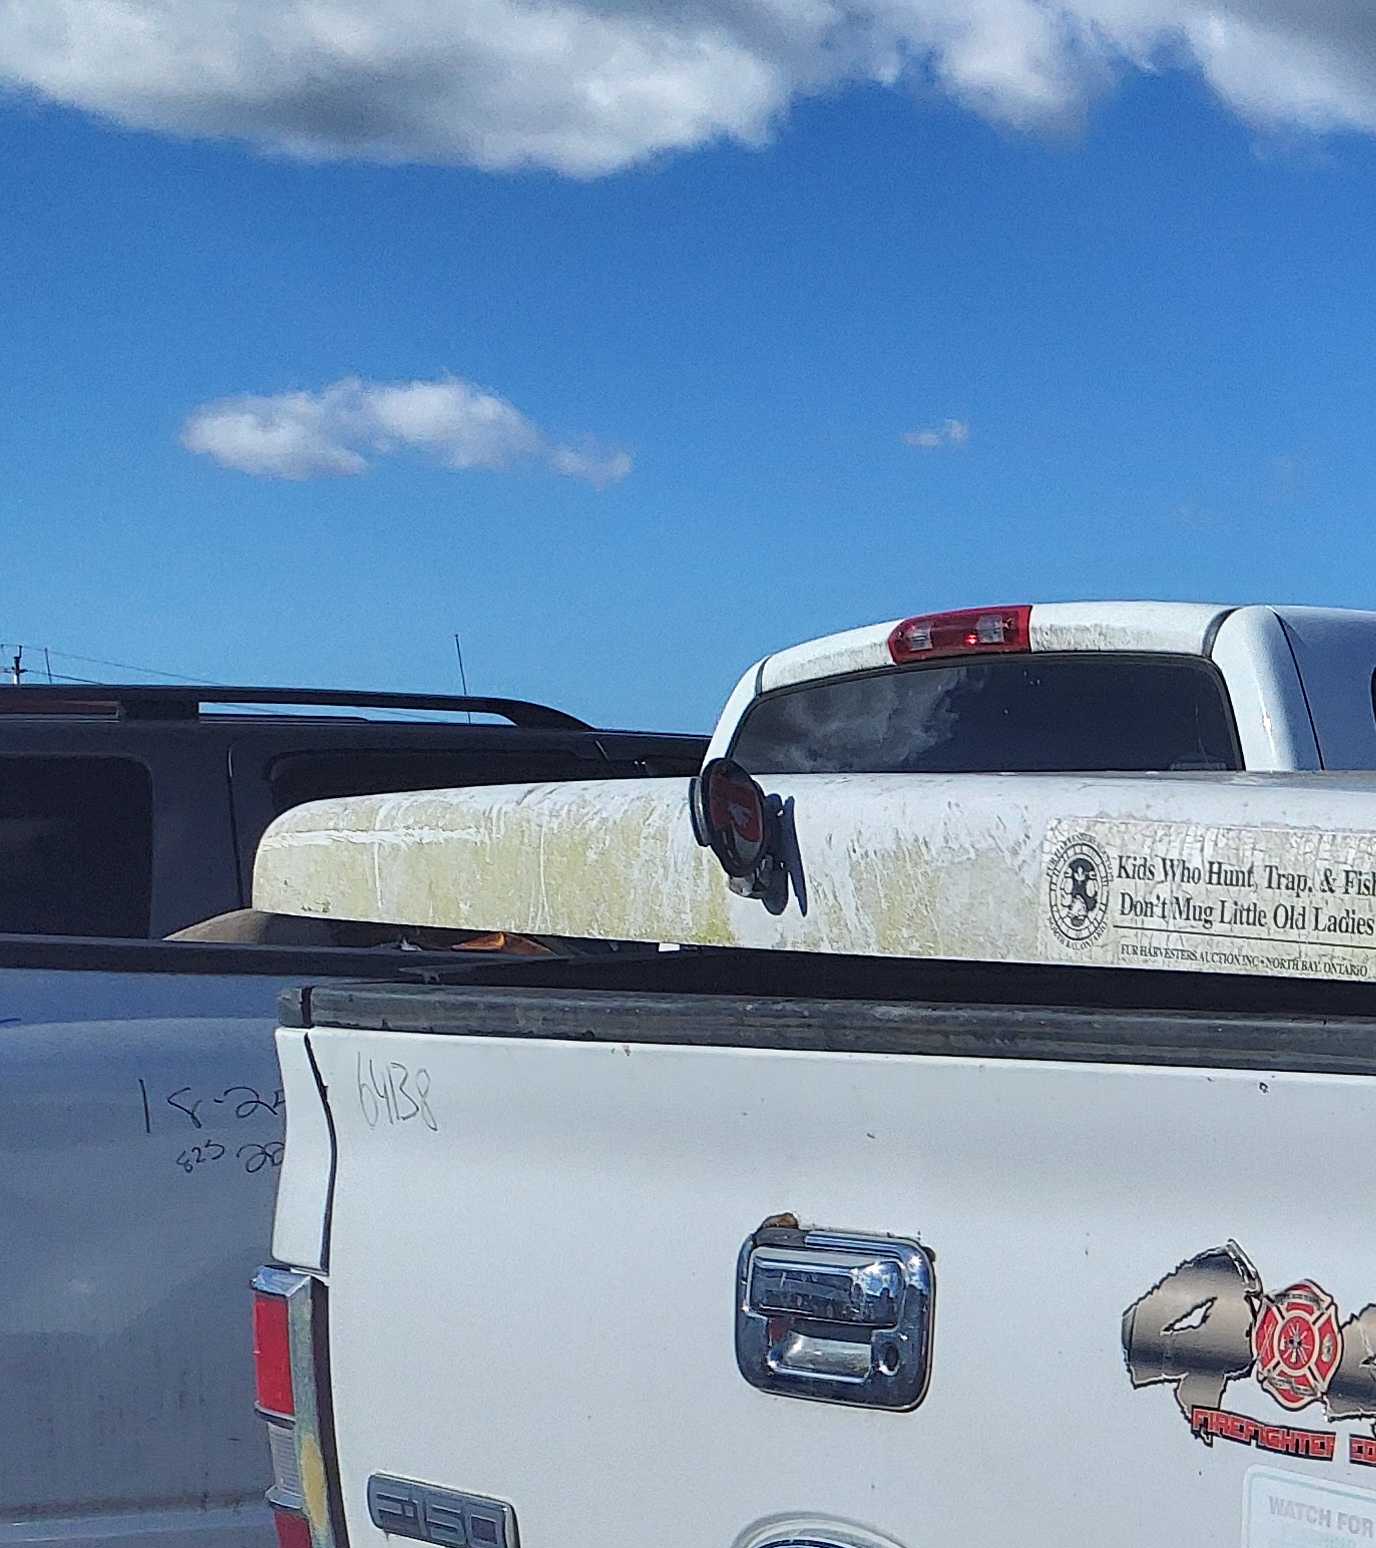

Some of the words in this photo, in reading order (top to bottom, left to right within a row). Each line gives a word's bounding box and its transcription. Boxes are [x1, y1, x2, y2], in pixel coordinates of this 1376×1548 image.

[1117, 854, 1156, 881] Kids
[1158, 856, 1202, 885] Who
[1320, 868, 1338, 894] &
[1120, 892, 1168, 919] Don't
[1173, 895, 1215, 929] Mug
[1219, 900, 1267, 928] Little
[1273, 903, 1307, 930] Old
[1312, 905, 1375, 936] Ladies
[1200, 951, 1241, 966] AUCTION
[1265, 957, 1300, 971] NORTH
[1323, 962, 1368, 977] ONTARIO
[1192, 1405, 1336, 1462] FIREFIGHTER
[1268, 1495, 1332, 1528] WATCH
[1337, 1511, 1374, 1539] FOR
